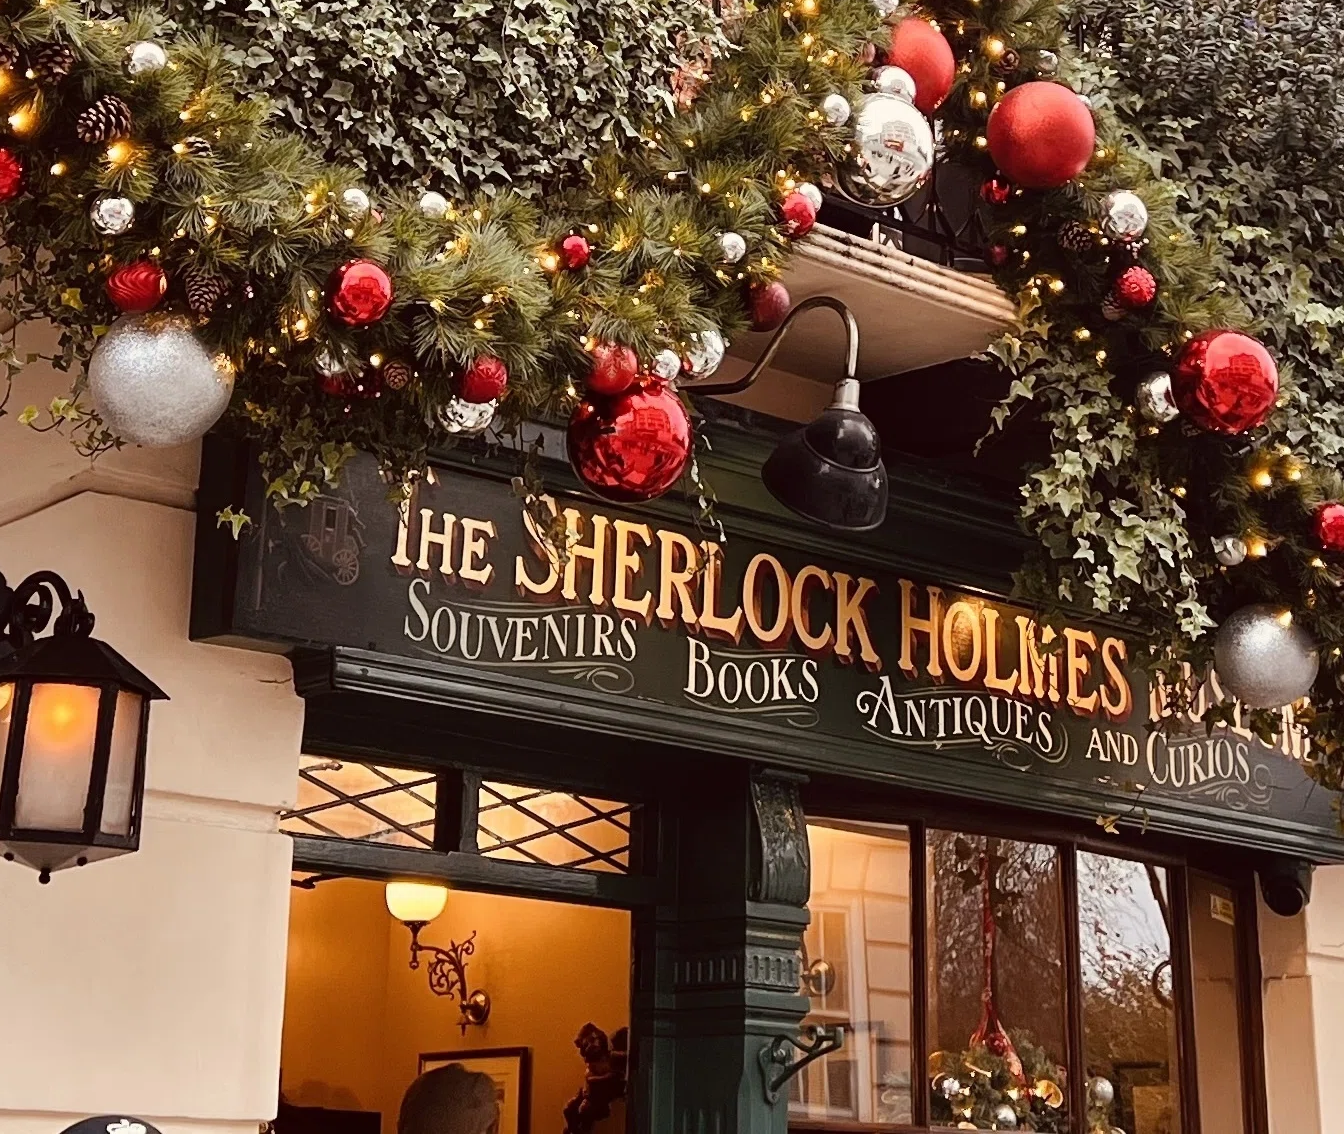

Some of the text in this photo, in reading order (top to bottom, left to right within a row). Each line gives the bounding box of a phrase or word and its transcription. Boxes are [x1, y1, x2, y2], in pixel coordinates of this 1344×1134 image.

[390, 468, 497, 585] THE
[516, 493, 881, 669] SHERLOCK
[897, 578, 1128, 716] HOLMES
[403, 578, 1251, 787] SOUVENIRS BOOKS ANTIQUES AND CURIOS
